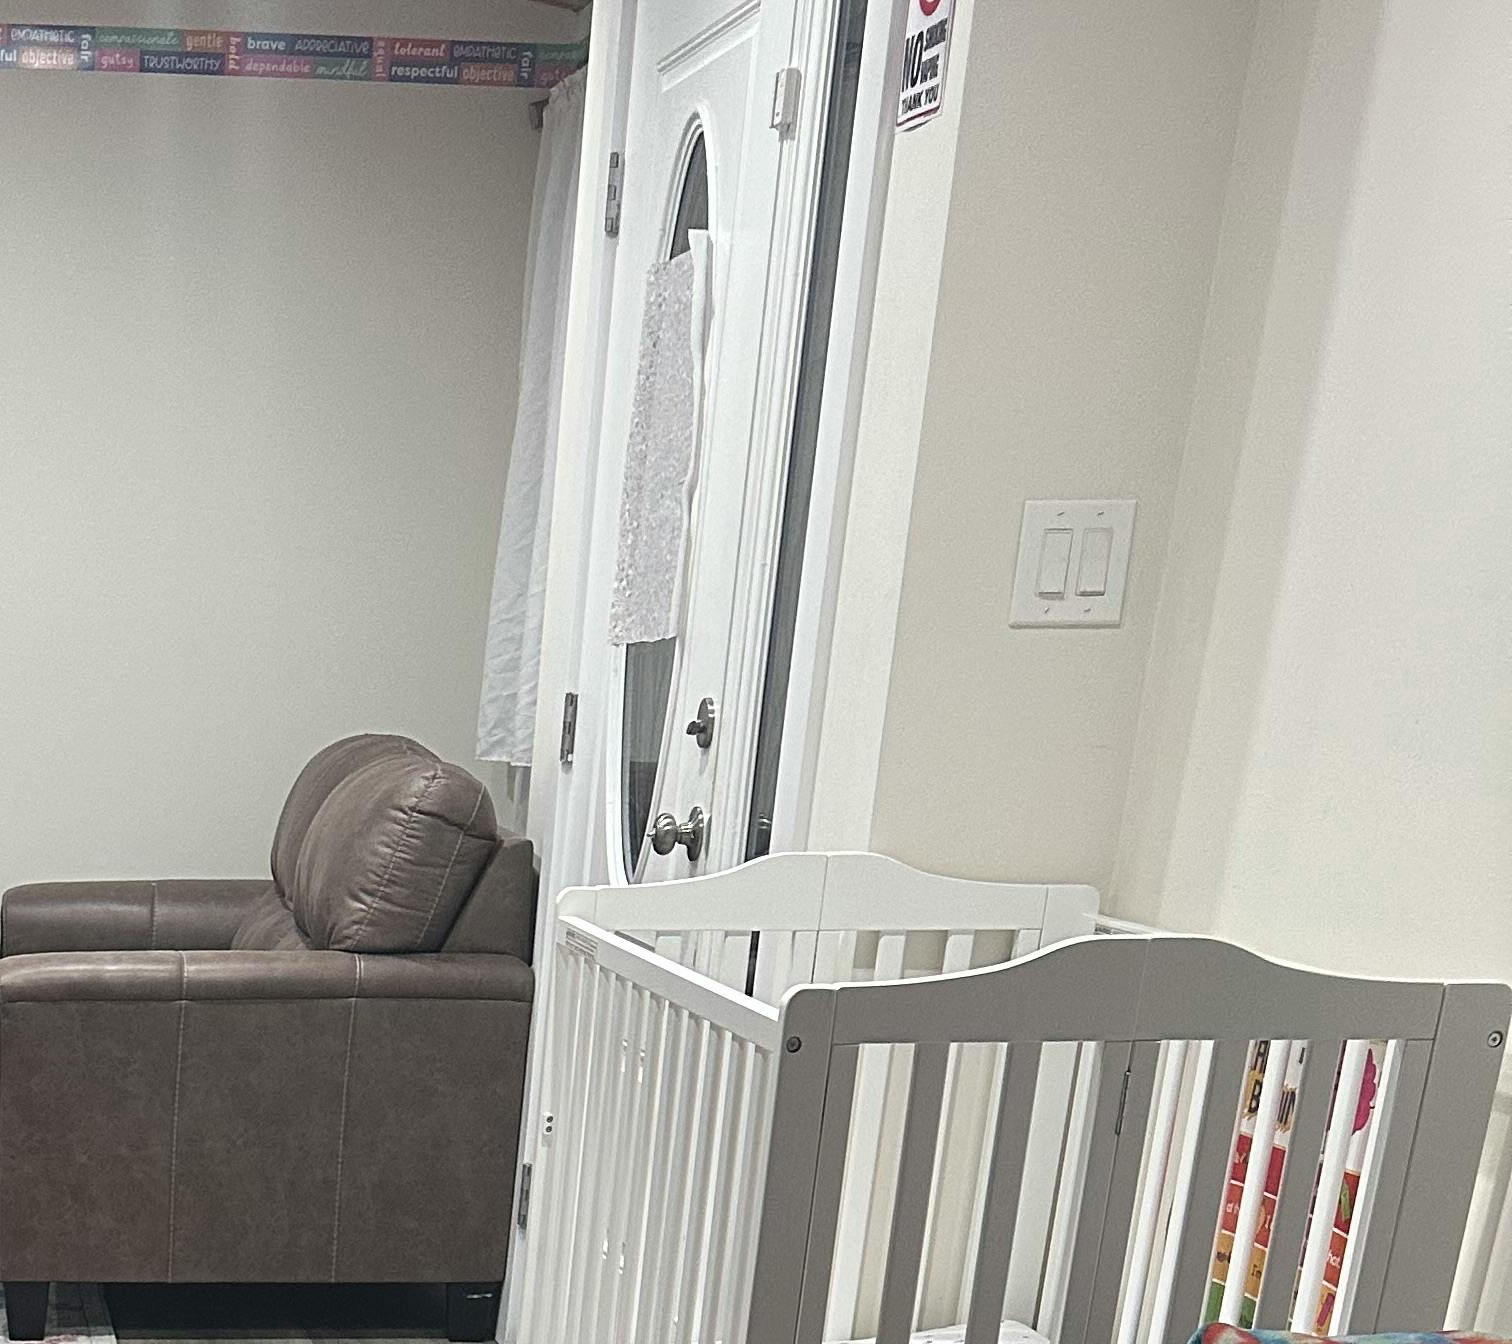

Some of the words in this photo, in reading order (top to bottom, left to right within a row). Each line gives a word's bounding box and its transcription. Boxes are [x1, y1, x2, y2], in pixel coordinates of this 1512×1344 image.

[247, 38, 286, 50] brave
[901, 30, 924, 93] NO
[391, 66, 458, 79] respectful
